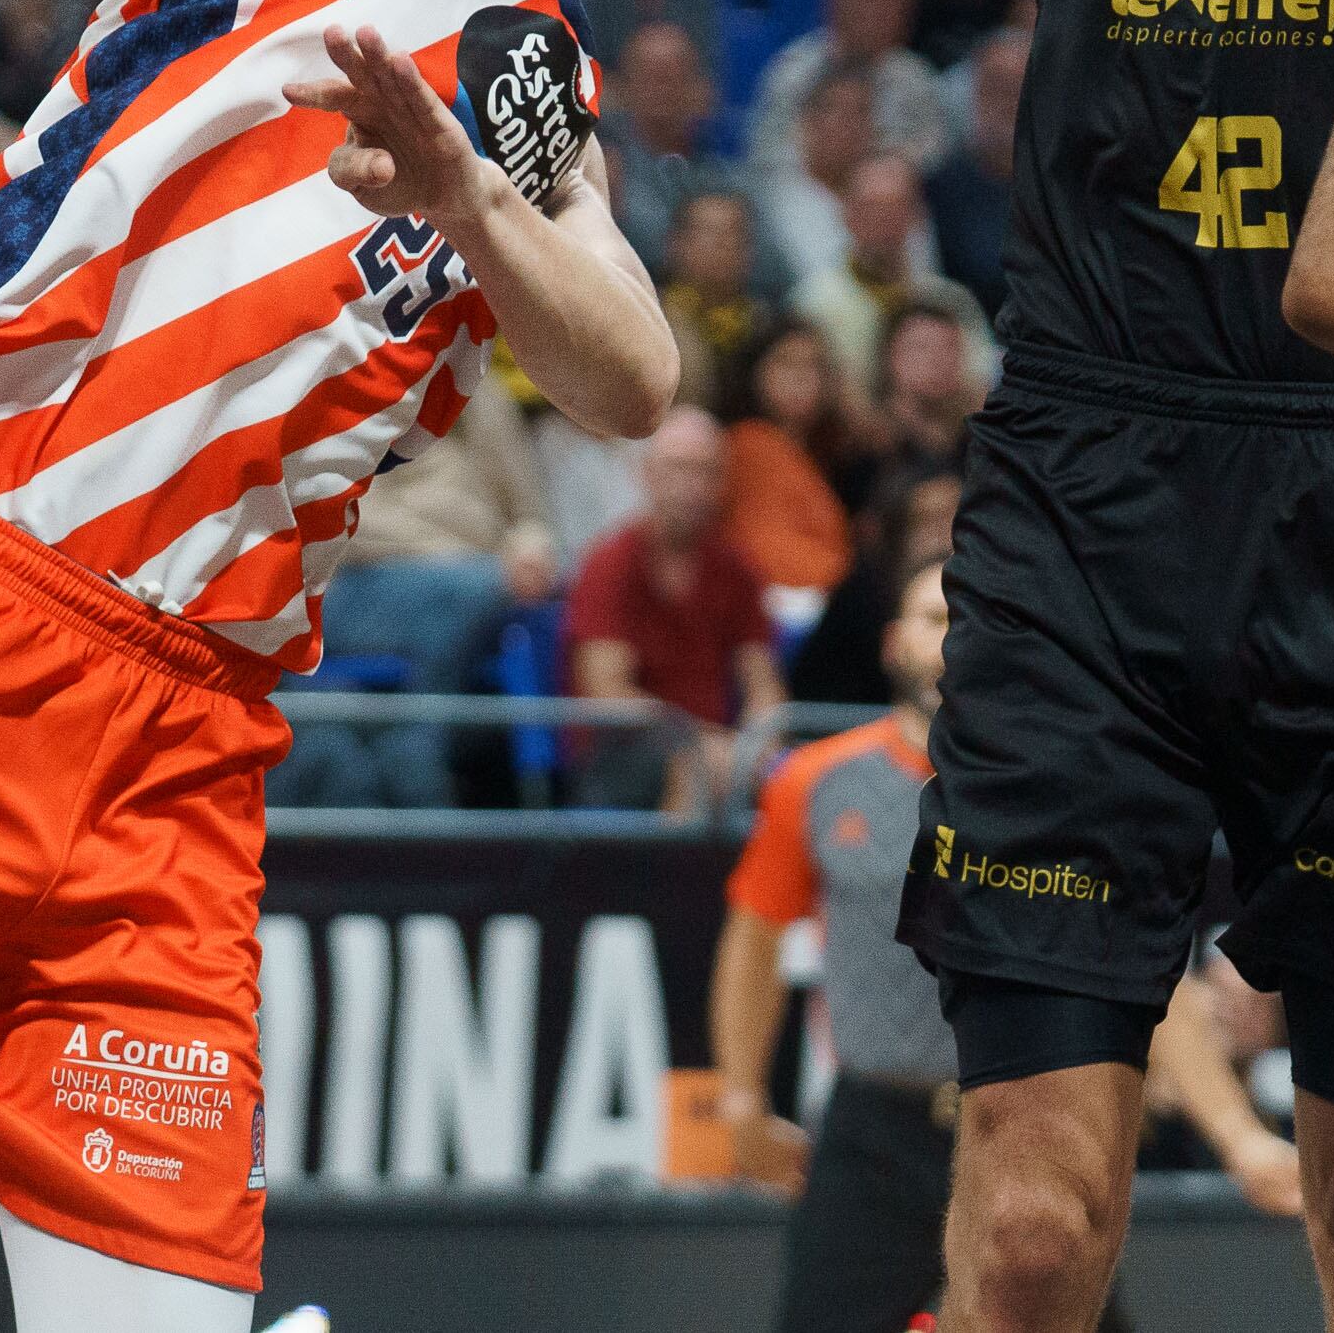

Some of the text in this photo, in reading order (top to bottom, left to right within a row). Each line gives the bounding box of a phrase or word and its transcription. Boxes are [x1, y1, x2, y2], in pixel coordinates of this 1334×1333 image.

[1158, 115, 1290, 249] 42
[961, 852, 1110, 904] Hospiten
[63, 1023, 230, 1077] A Coruña
[51, 1066, 233, 1110] UNHA PROVINCIA
[54, 1088, 224, 1131] POR DESCUBRIR
[115, 1161, 181, 1182] DA CORUÑA
[117, 1148, 184, 1171] Deputación
